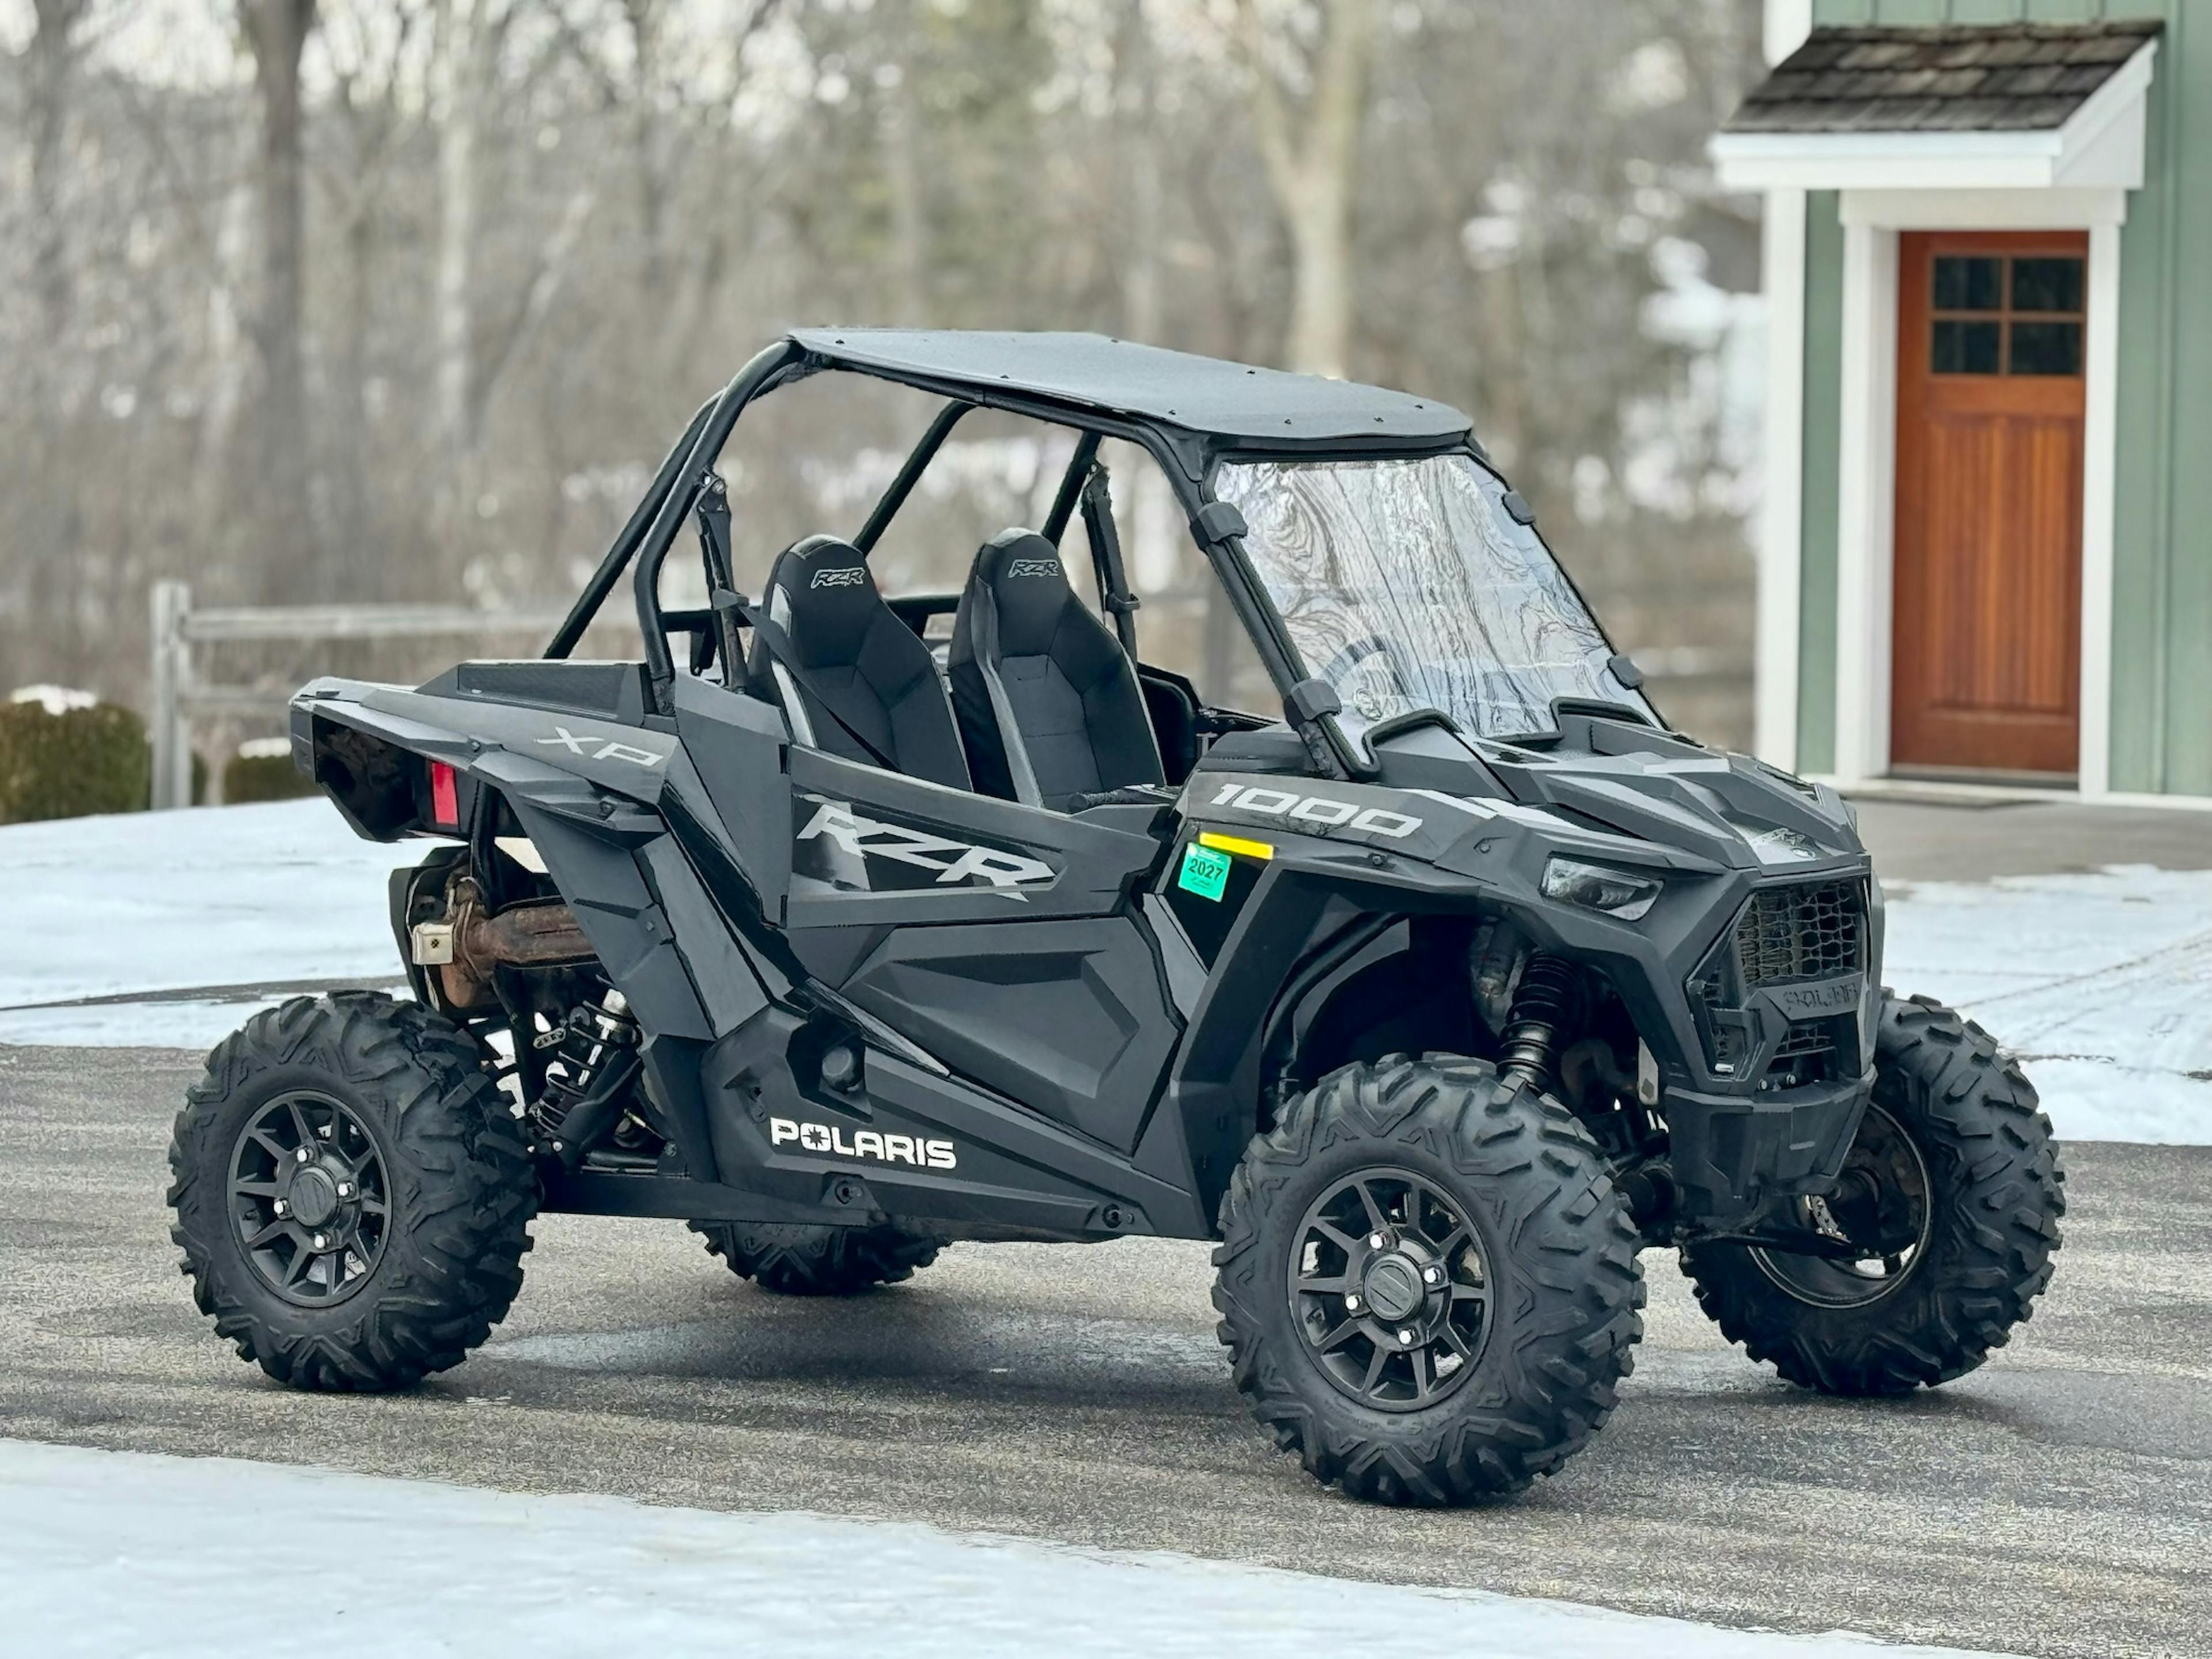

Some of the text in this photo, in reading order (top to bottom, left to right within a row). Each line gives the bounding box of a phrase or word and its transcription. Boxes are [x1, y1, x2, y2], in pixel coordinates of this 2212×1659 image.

[810, 567, 866, 589] RZR
[1008, 559, 1059, 578] RZR
[533, 726, 664, 767] XP
[1210, 783, 1423, 838] 1000
[797, 804, 1056, 903] RZR
[1188, 858, 1224, 882] 2027
[770, 1117, 957, 1169] POLARIS
